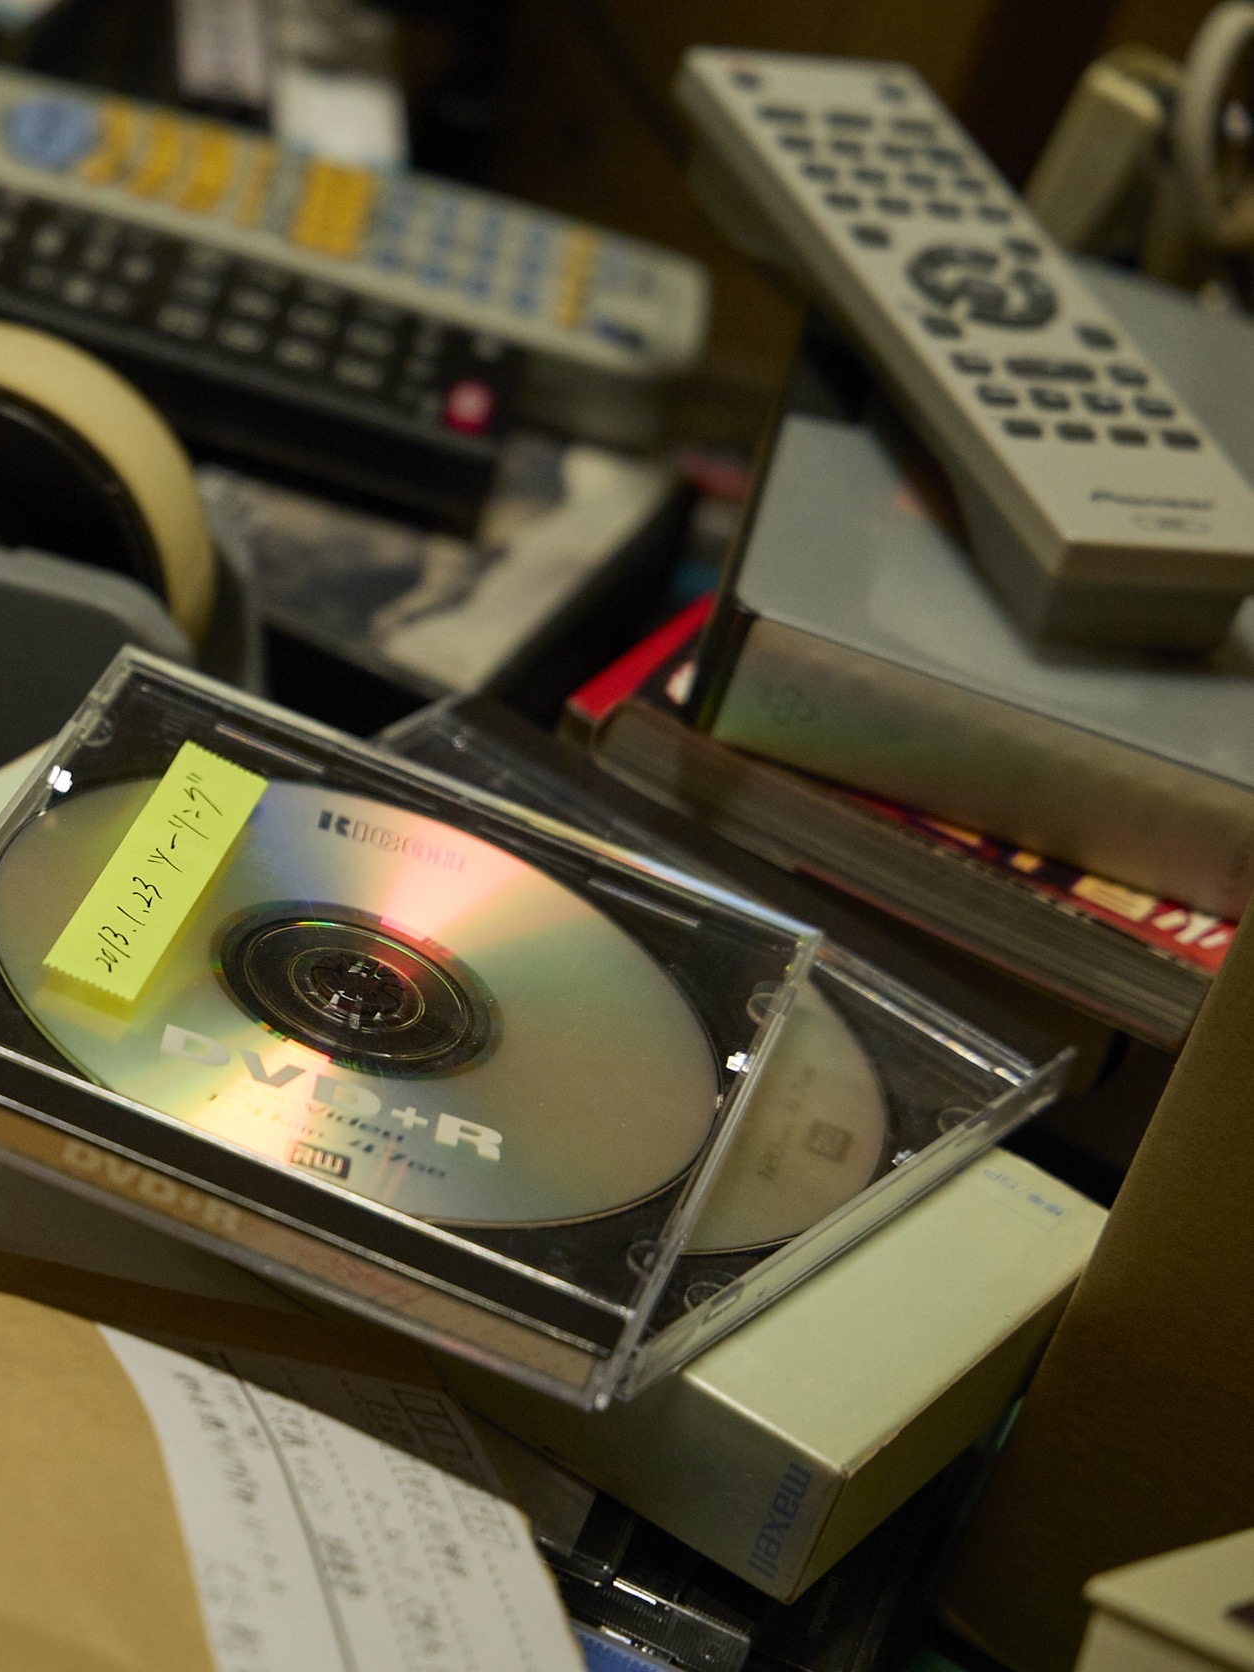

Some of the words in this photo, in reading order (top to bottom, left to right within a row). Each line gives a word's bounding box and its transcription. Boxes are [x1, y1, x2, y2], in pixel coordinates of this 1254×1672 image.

[159, 1023, 503, 1161] DVD+R
[60, 1136, 242, 1234] DVD+R
[748, 1461, 813, 1580] maxell
